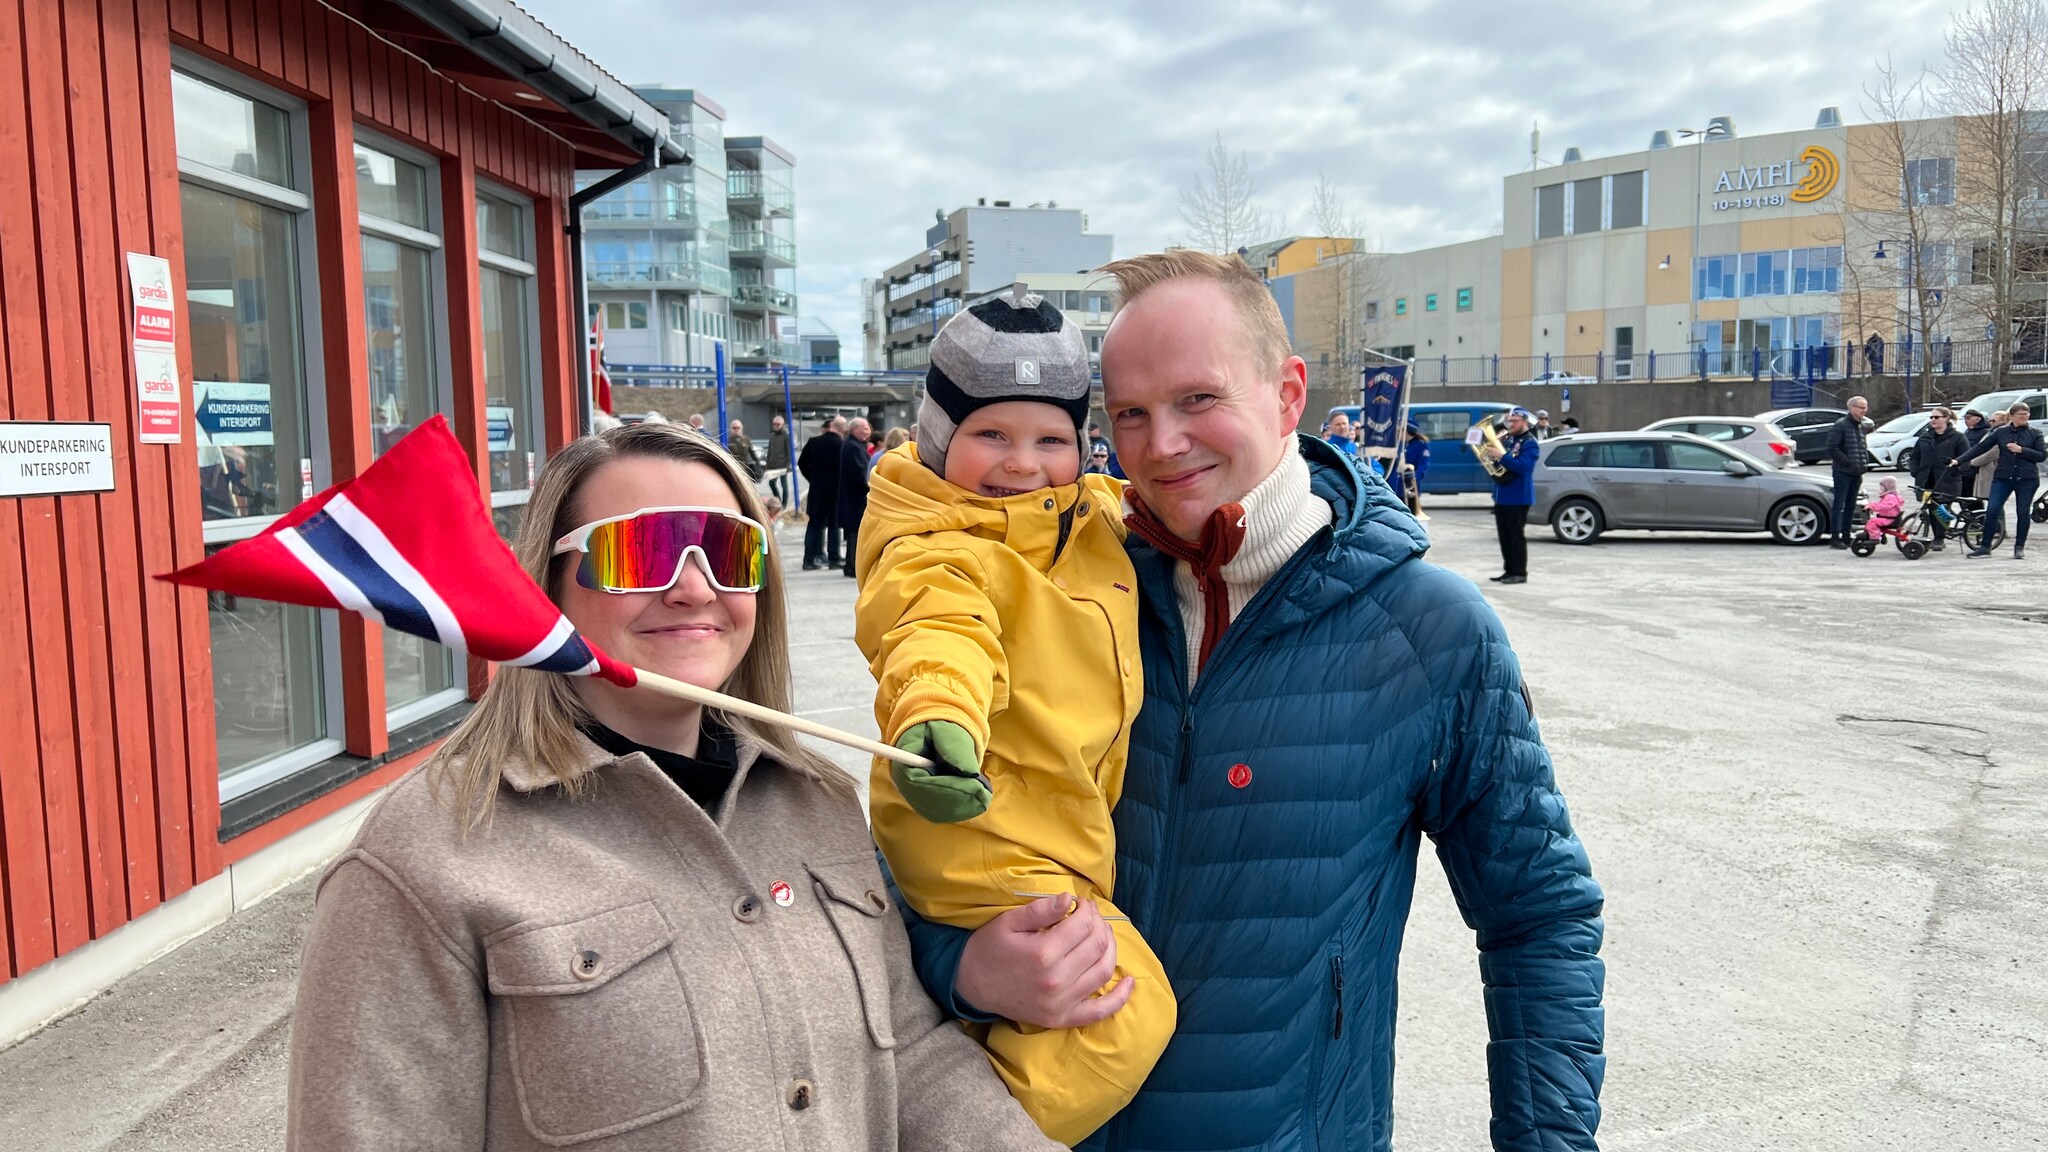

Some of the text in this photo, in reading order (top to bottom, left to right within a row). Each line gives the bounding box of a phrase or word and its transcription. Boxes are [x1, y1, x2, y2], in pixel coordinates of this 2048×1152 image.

[1713, 159, 1794, 193] AMFI
[1713, 194, 1785, 211] 10-19 (18)
[139, 286, 168, 299] gardia
[140, 314, 170, 329] ALARM
[144, 379, 174, 394] gardia
[208, 403, 270, 414] KUNDEPARKERING
[219, 417, 261, 428] INTERSPORT
[0, 439, 105, 454] KUNDEPARKERING
[20, 461, 91, 477] INTERSPORT
